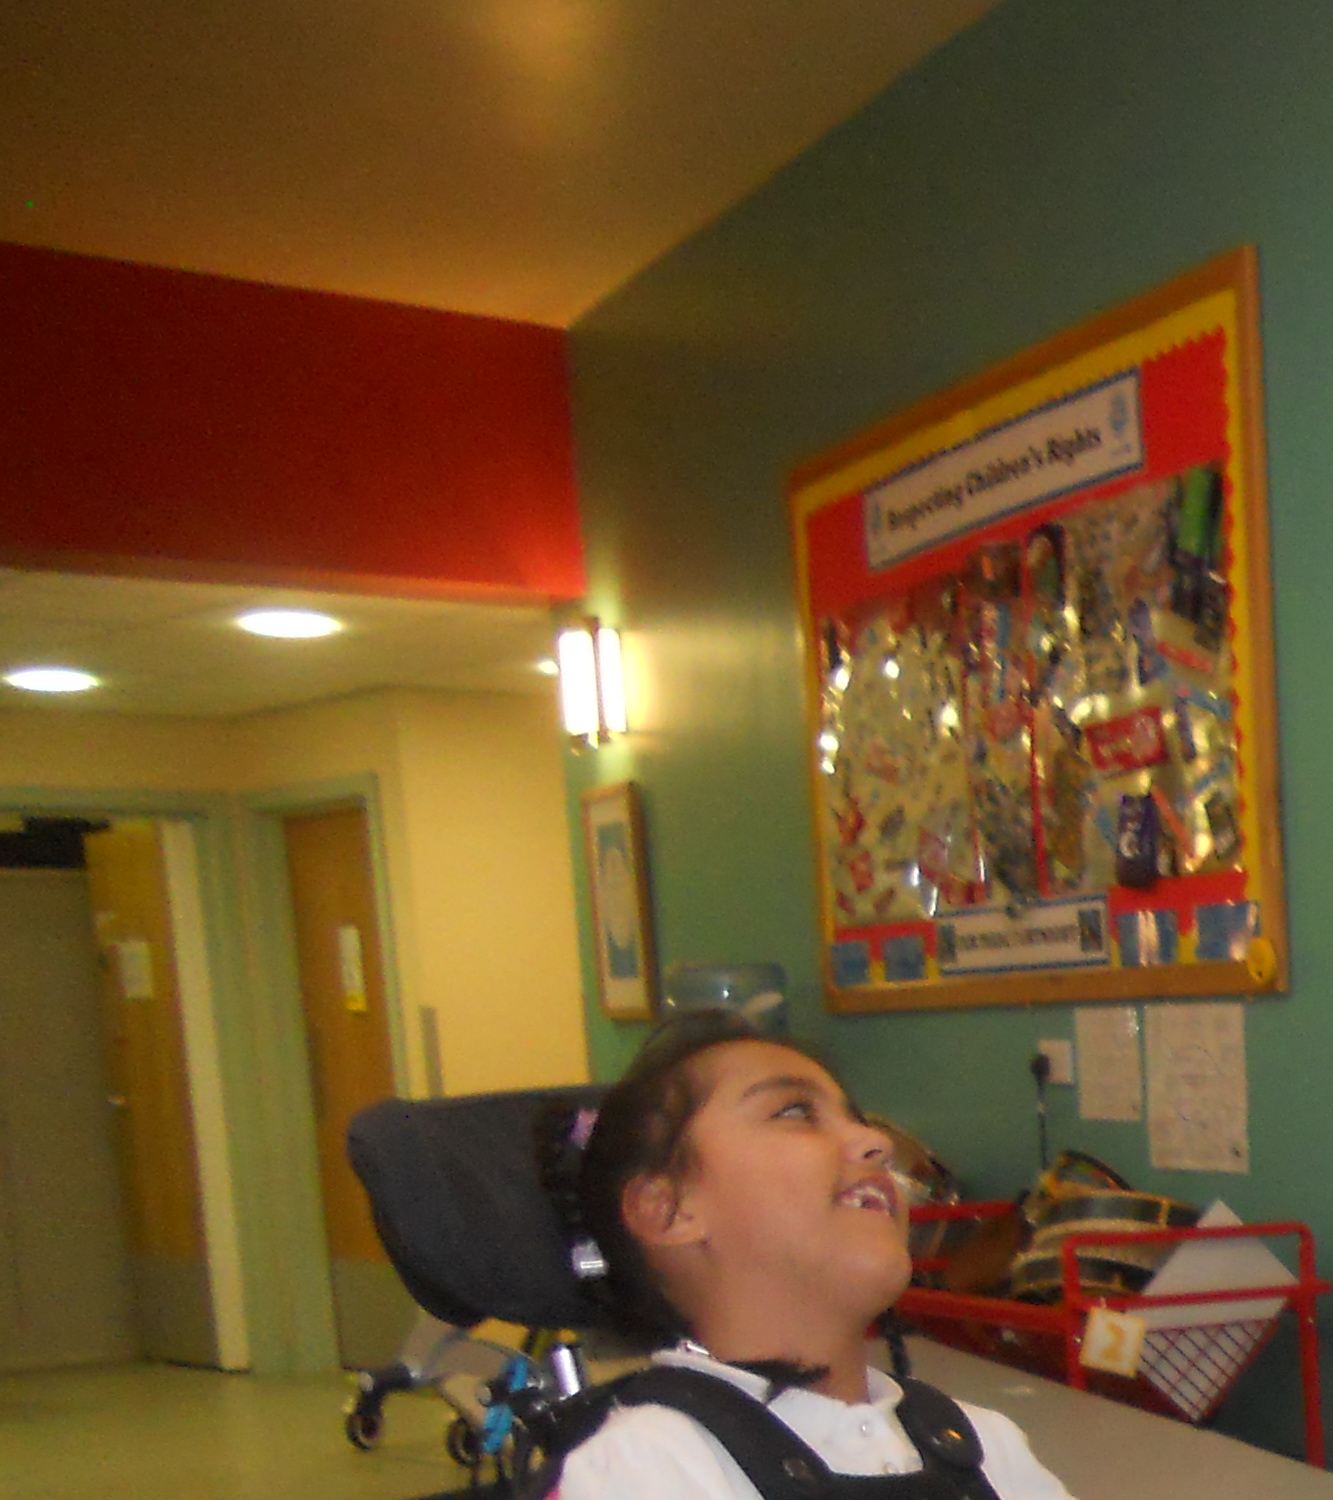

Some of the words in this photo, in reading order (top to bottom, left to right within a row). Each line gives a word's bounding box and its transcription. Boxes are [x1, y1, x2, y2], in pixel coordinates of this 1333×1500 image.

[887, 483, 965, 531] Respecting
[964, 445, 1045, 497] Children's
[1046, 427, 1102, 467] Rights
